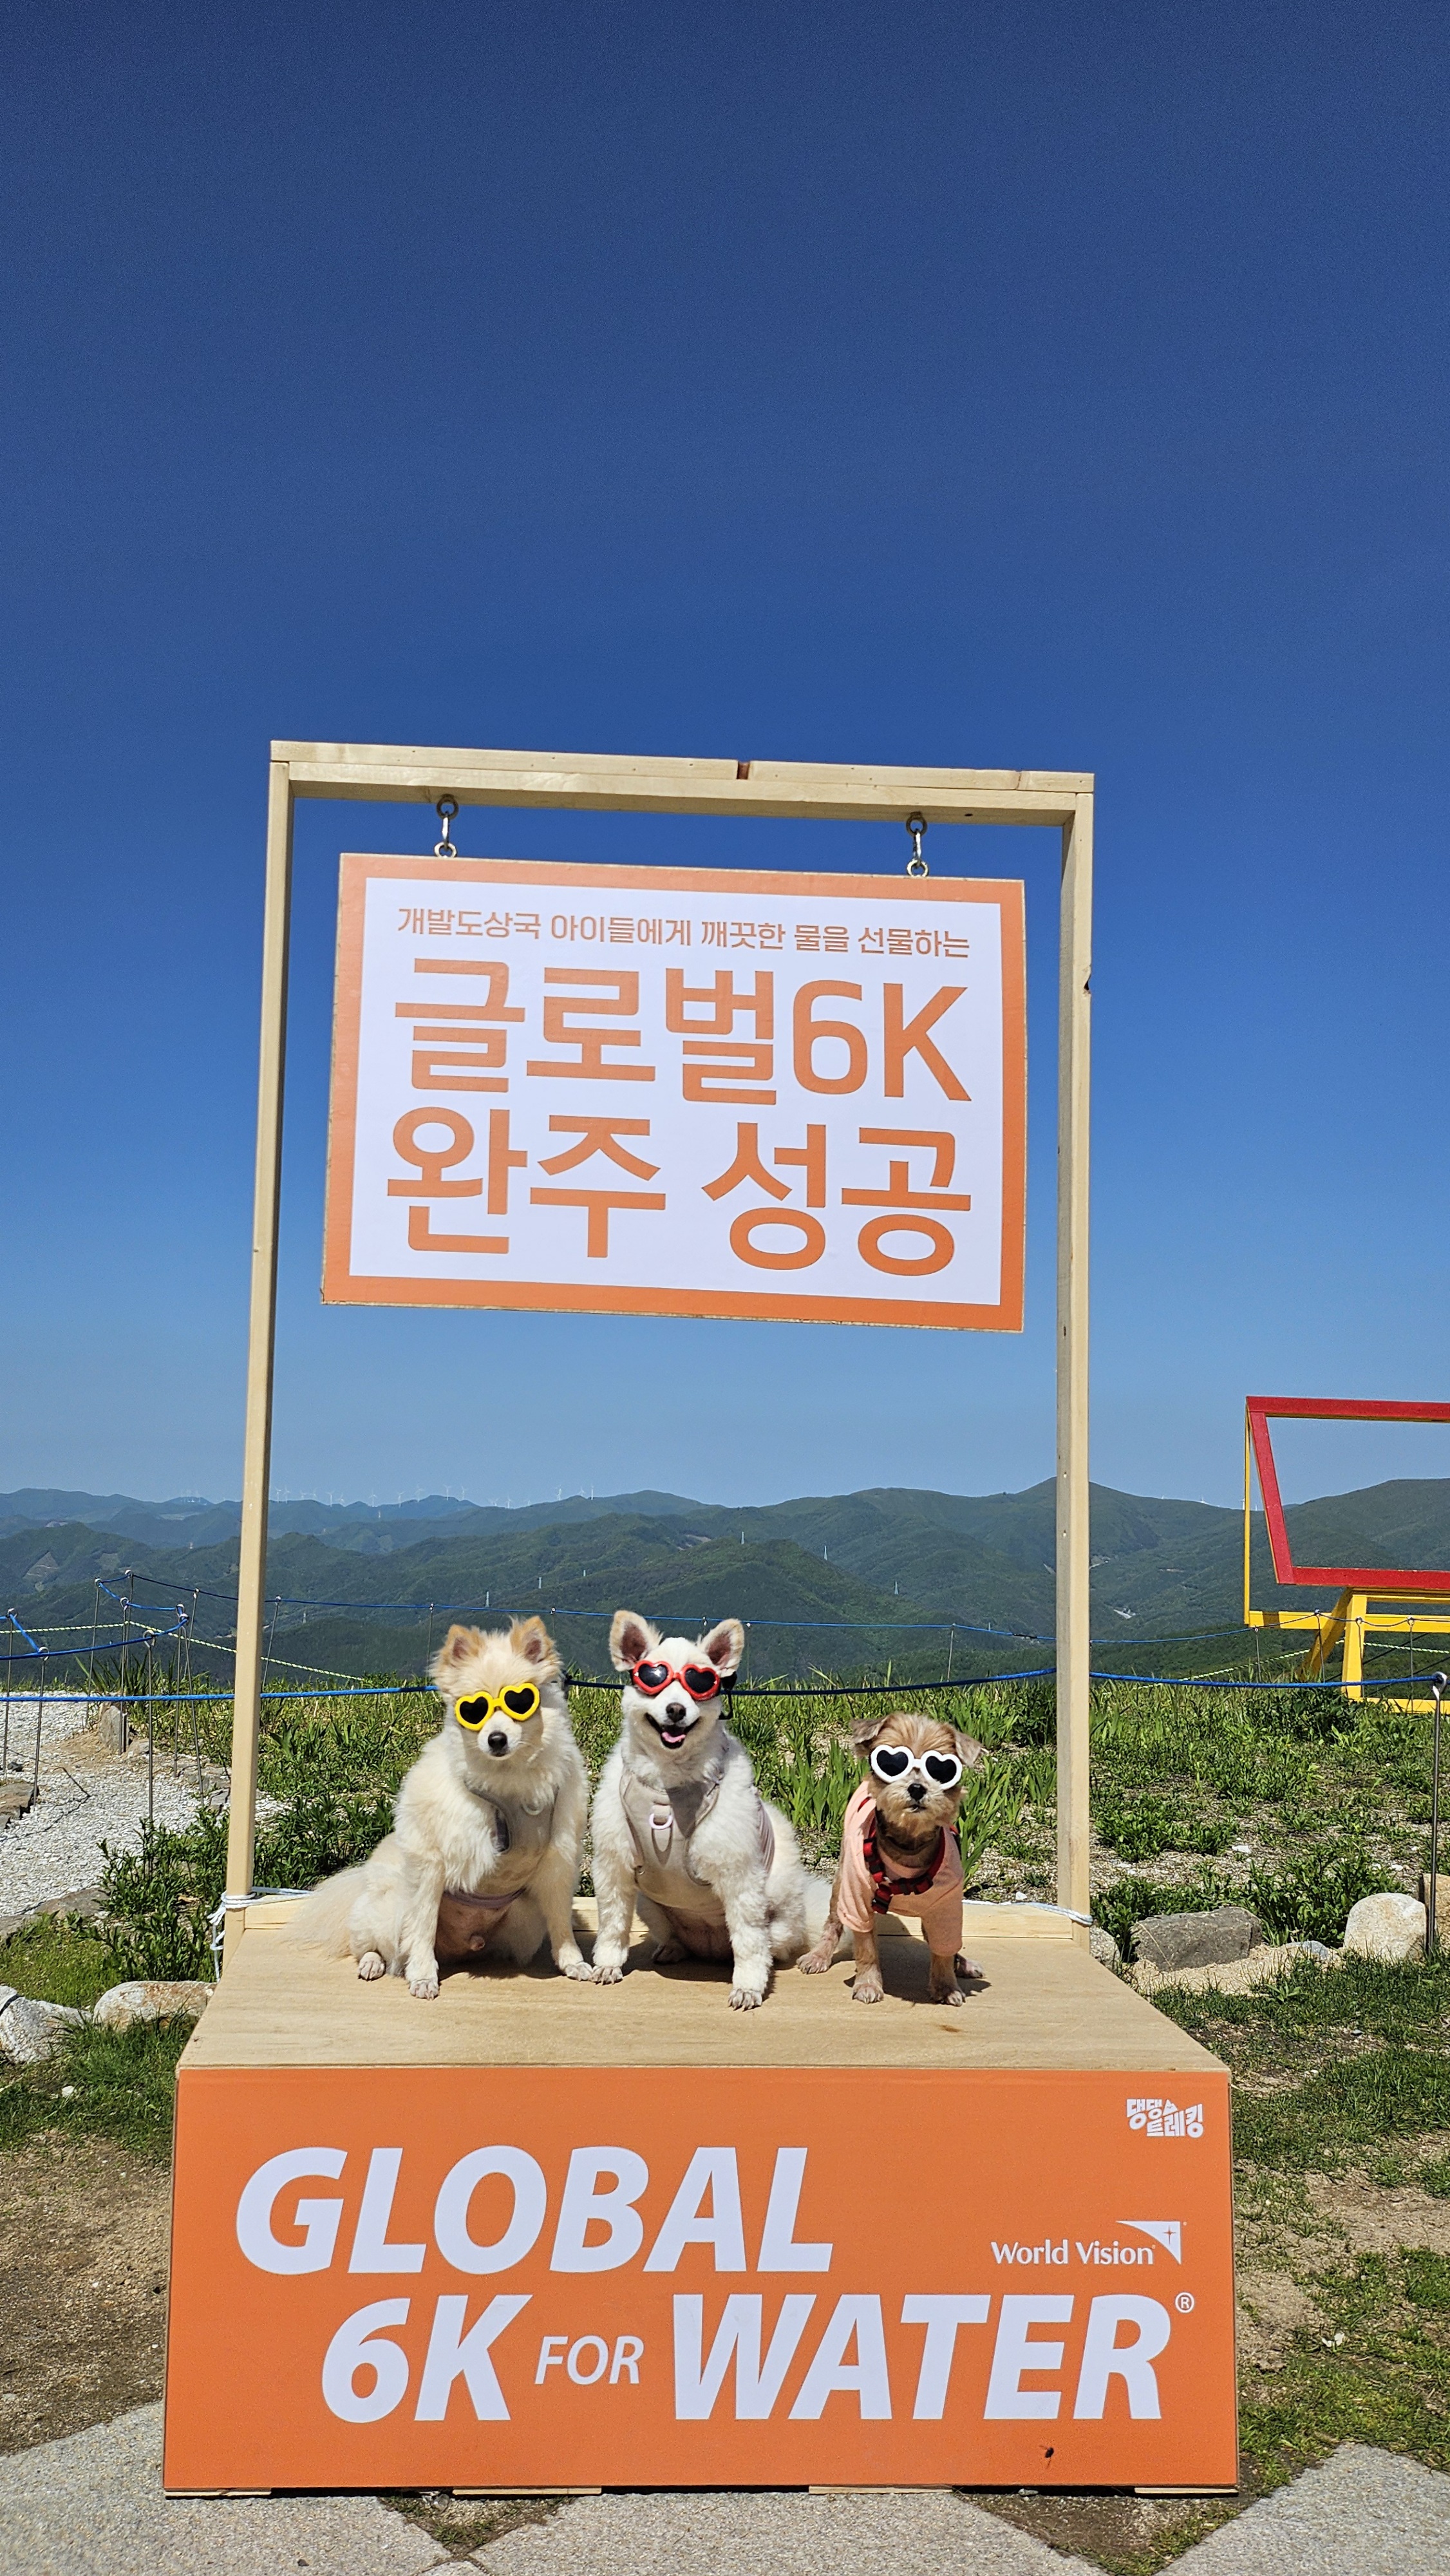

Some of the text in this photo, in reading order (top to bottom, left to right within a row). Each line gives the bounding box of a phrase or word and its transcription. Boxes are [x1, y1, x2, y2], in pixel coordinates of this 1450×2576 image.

[397, 907, 970, 958] 개발도상국 아이들에게 깨끗한 물을 선물하는
[394, 958, 973, 1106] 글로벌6K
[387, 1107, 972, 1277] 완주 성공
[236, 2145, 834, 2275] GLOBAL
[990, 2239, 1154, 2265] World Vision
[321, 2294, 533, 2421] 6K
[534, 2335, 644, 2385] FOR
